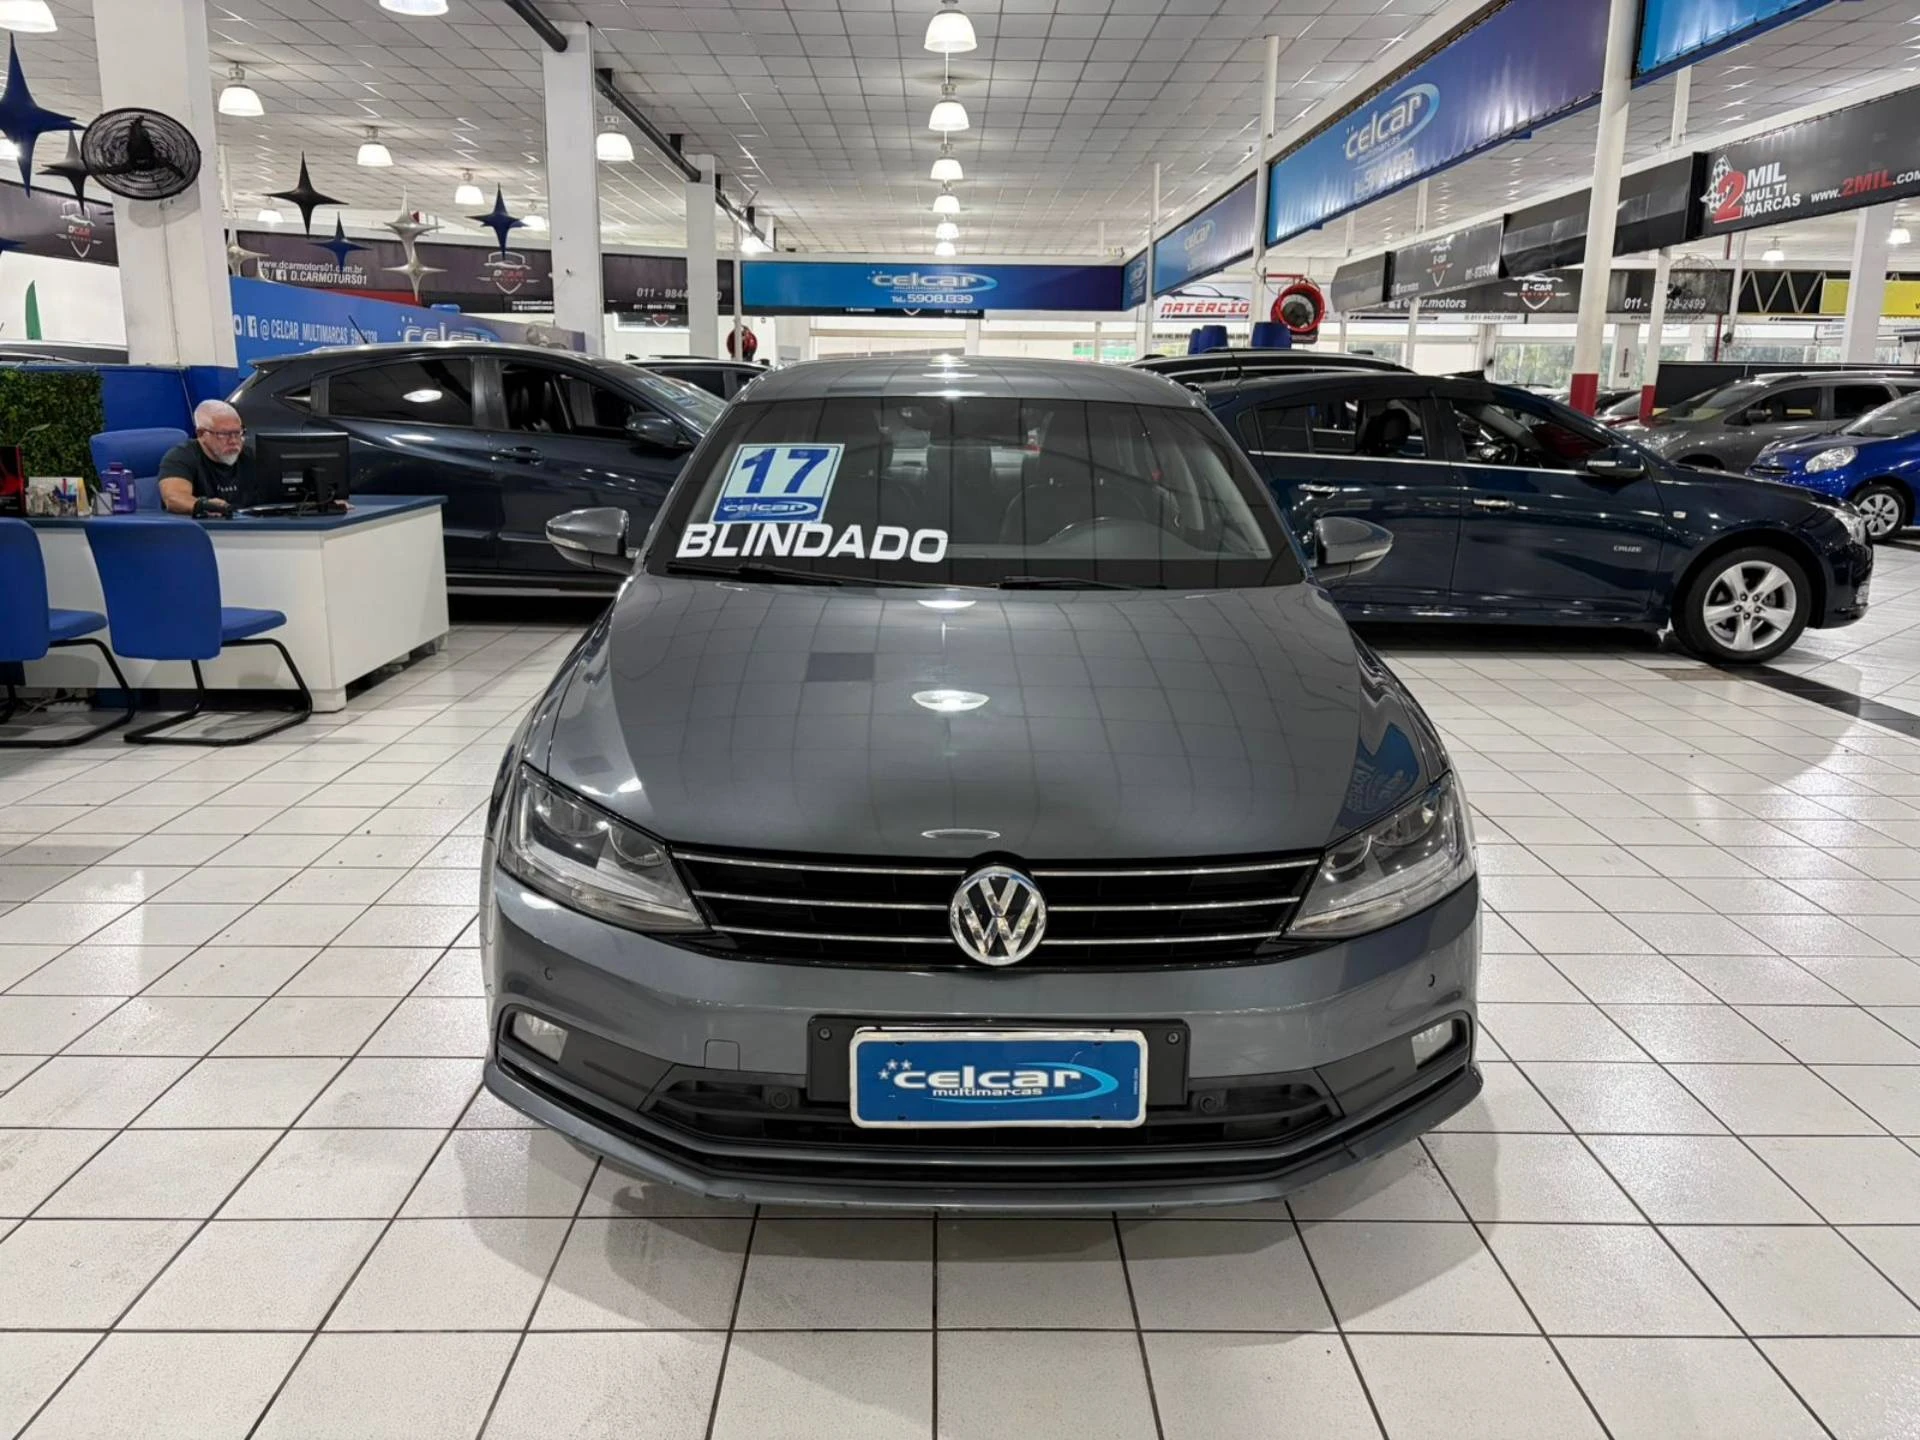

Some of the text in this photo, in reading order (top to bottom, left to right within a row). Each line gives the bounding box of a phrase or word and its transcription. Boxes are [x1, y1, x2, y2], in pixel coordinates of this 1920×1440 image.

[1346, 94, 1422, 160] celcar
[1714, 162, 1787, 224] 2 MIL
[1745, 182, 1787, 208] MULTI
[1744, 193, 1801, 219] MARCAS
[872, 272, 977, 288] celcar
[637, 288, 655, 298] 011
[1624, 298, 1641, 309] 011
[741, 448, 829, 494] 17
[723, 503, 804, 512] celcar
[676, 523, 949, 563] BLINDADO
[893, 1066, 1080, 1088] celcar
[932, 1087, 1042, 1097] multimarcas
